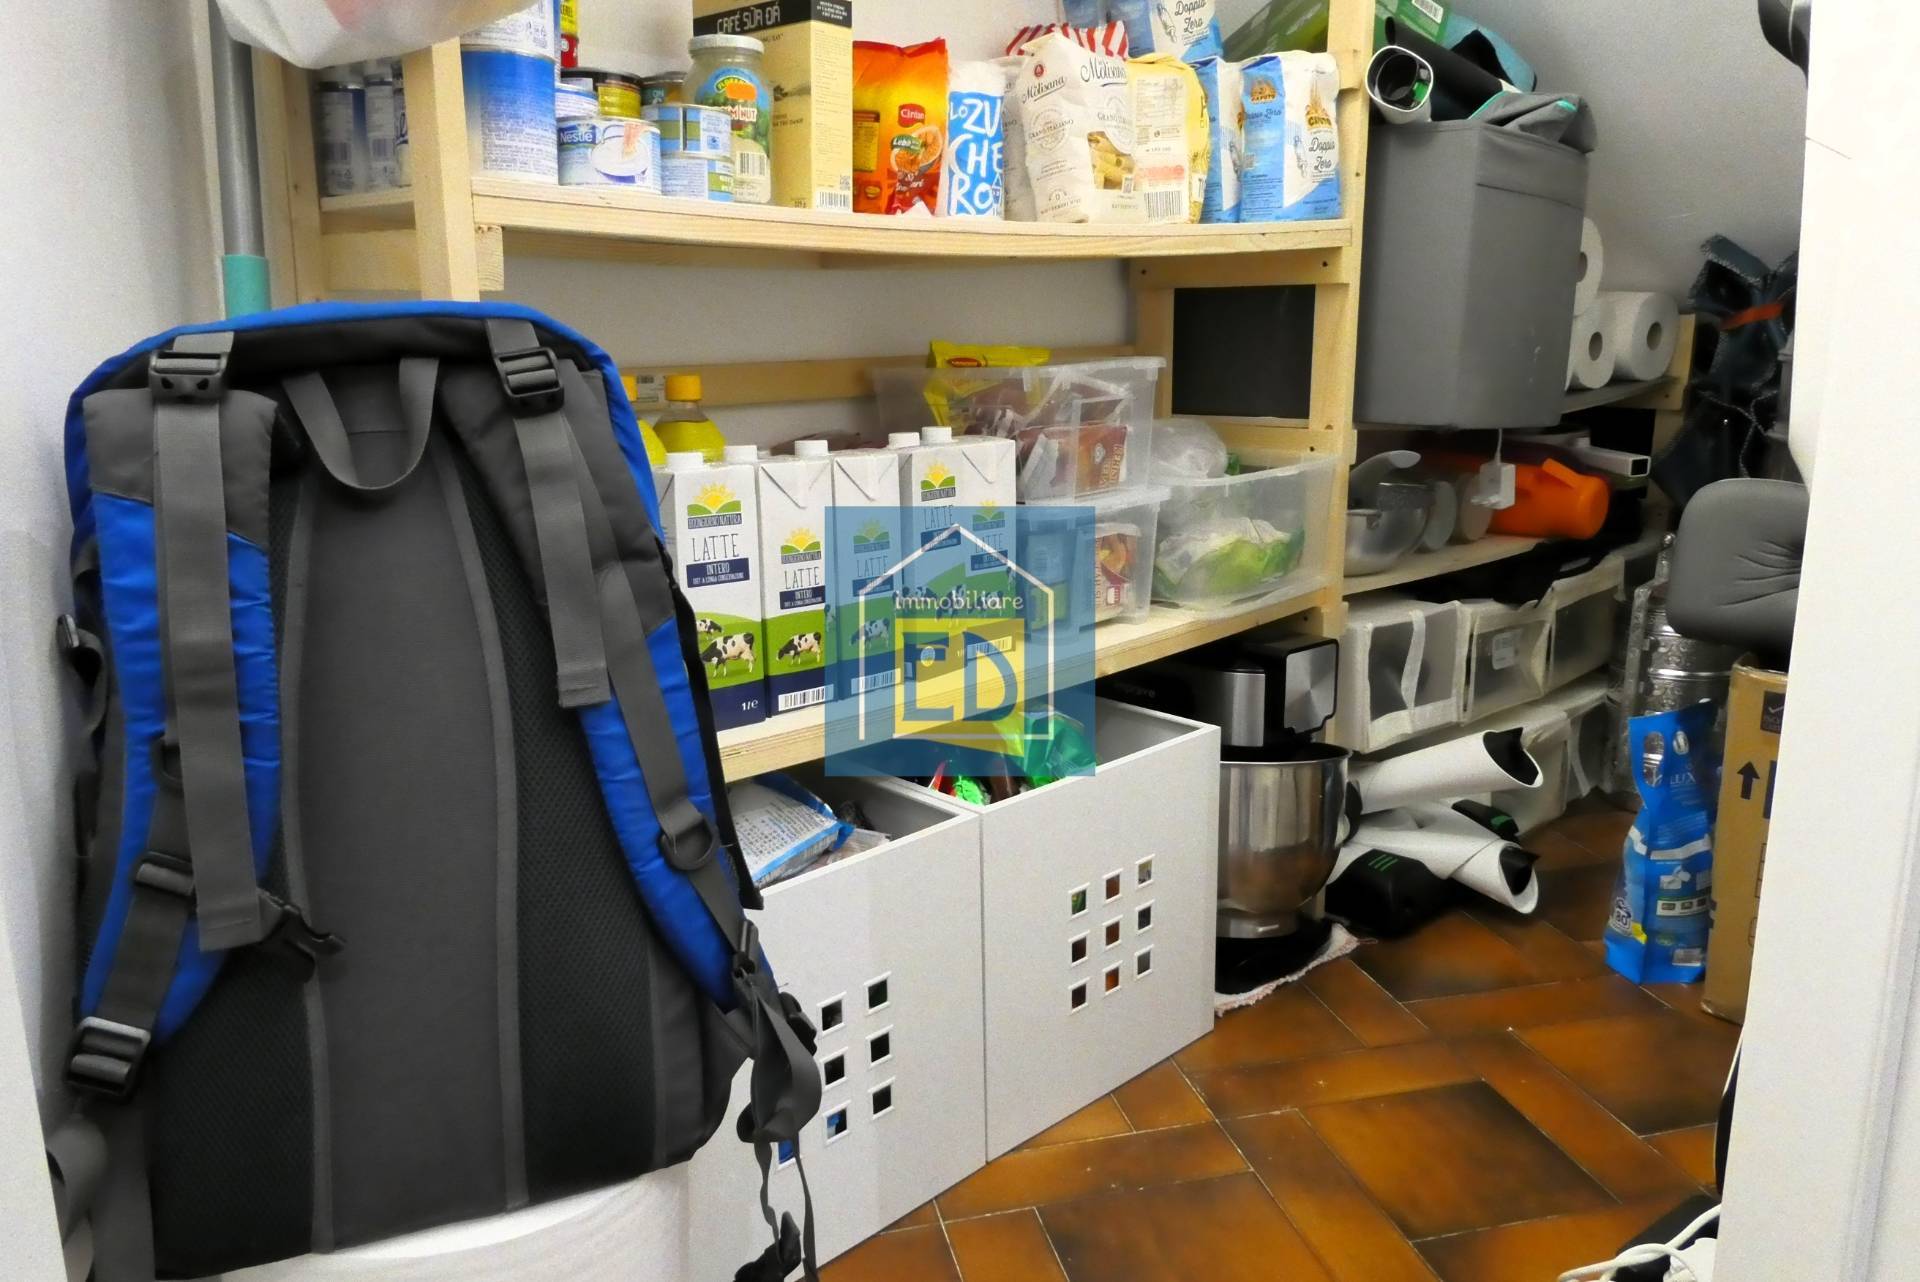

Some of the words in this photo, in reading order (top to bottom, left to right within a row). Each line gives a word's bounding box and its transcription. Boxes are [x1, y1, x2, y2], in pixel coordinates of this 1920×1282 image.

[1183, 17, 1203, 34] Zero
[923, 504, 955, 530] LATTE
[691, 533, 740, 561] LATTE
[706, 562, 730, 576] INTERO
[785, 566, 820, 590] LATTE
